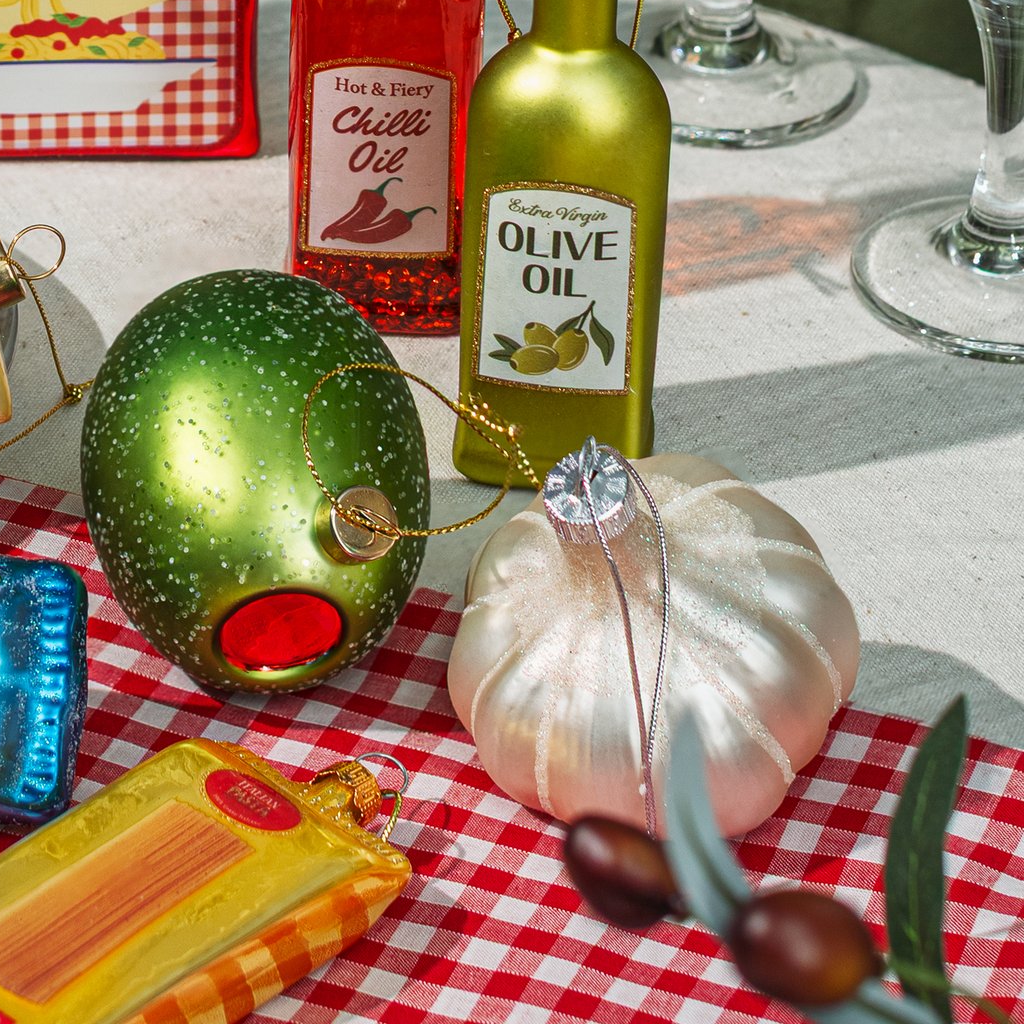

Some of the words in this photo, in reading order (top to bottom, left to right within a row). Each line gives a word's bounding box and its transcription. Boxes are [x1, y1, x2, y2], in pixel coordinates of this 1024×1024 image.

[335, 77, 367, 95] Hot
[371, 82, 386, 96] &
[389, 82, 434, 99] Fiery
[332, 106, 432, 137] Chilli
[348, 140, 408, 174] Oil
[508, 198, 554, 219] Extra
[556, 207, 608, 227] Virgin
[498, 221, 618, 261] OLIVE
[522, 264, 587, 297] OIL
[237, 780, 280, 810] ITALIAN
